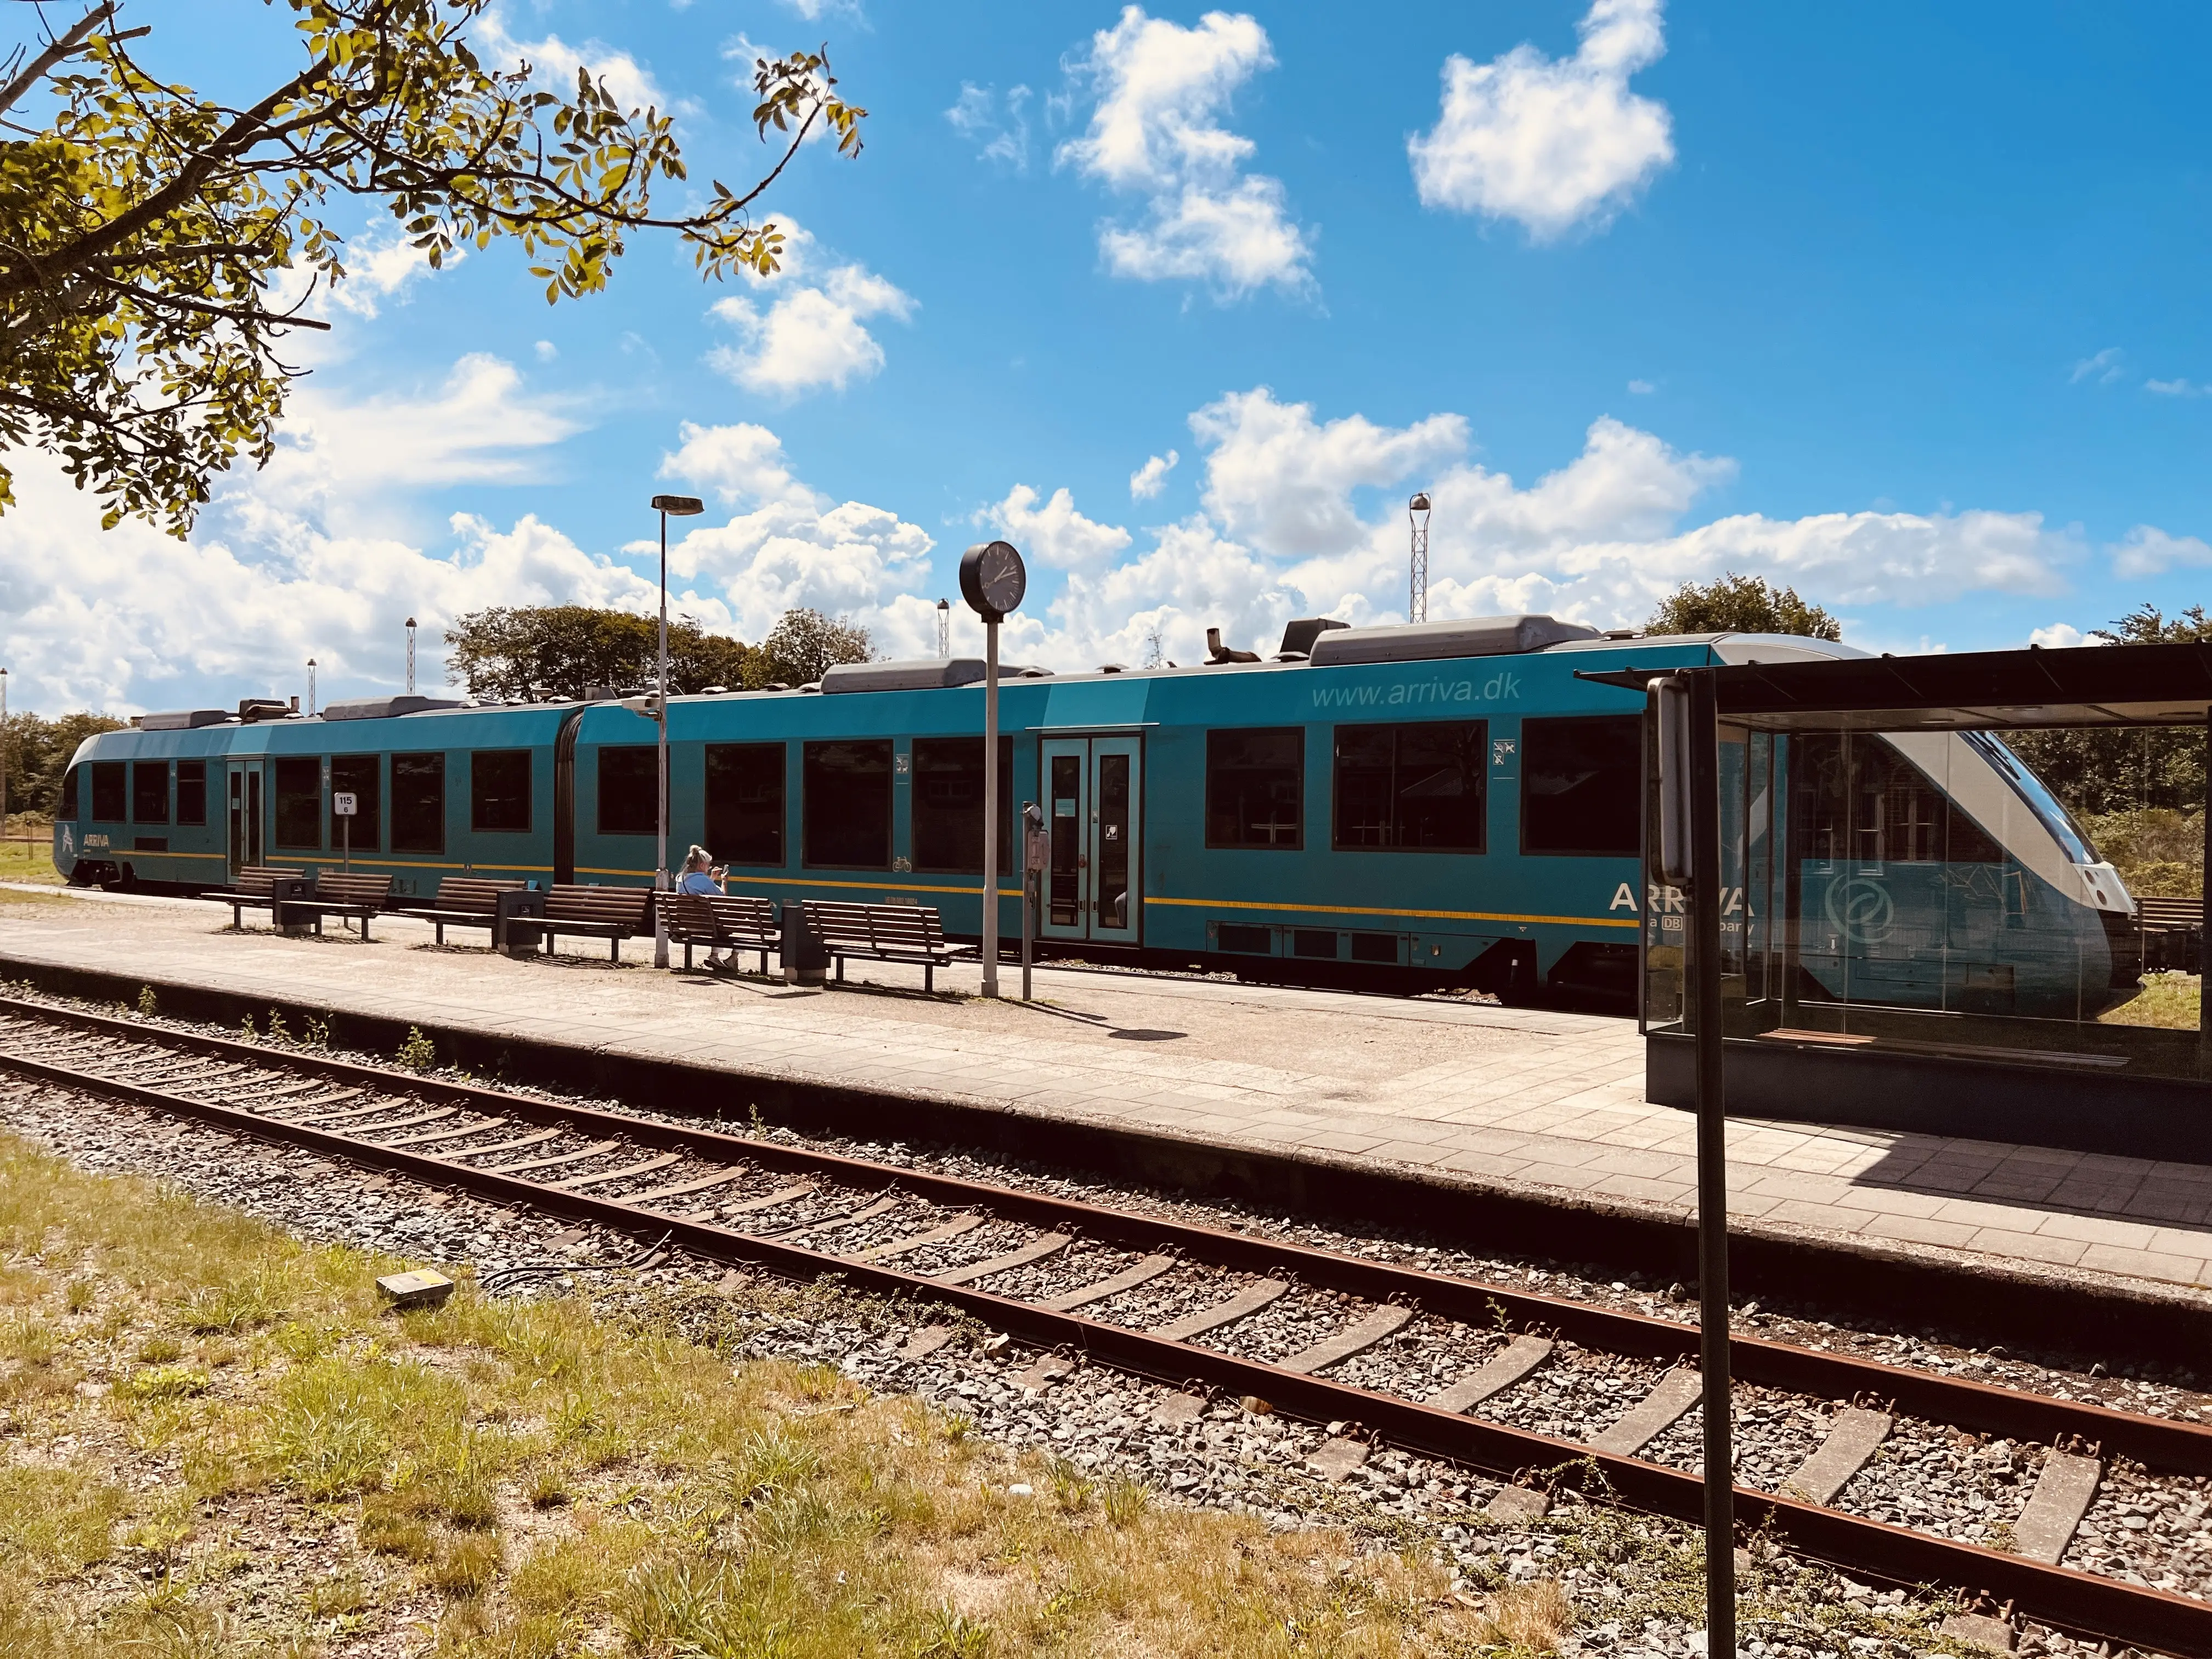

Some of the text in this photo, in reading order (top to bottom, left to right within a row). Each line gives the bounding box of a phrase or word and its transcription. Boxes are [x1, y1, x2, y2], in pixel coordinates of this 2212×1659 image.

[1312, 672, 1522, 707] www.arriva.dk
[340, 797, 352, 805] 115
[83, 834, 109, 847] ARRIVA
[1609, 883, 1754, 917] ARRA
[1664, 918, 1681, 929] DB
